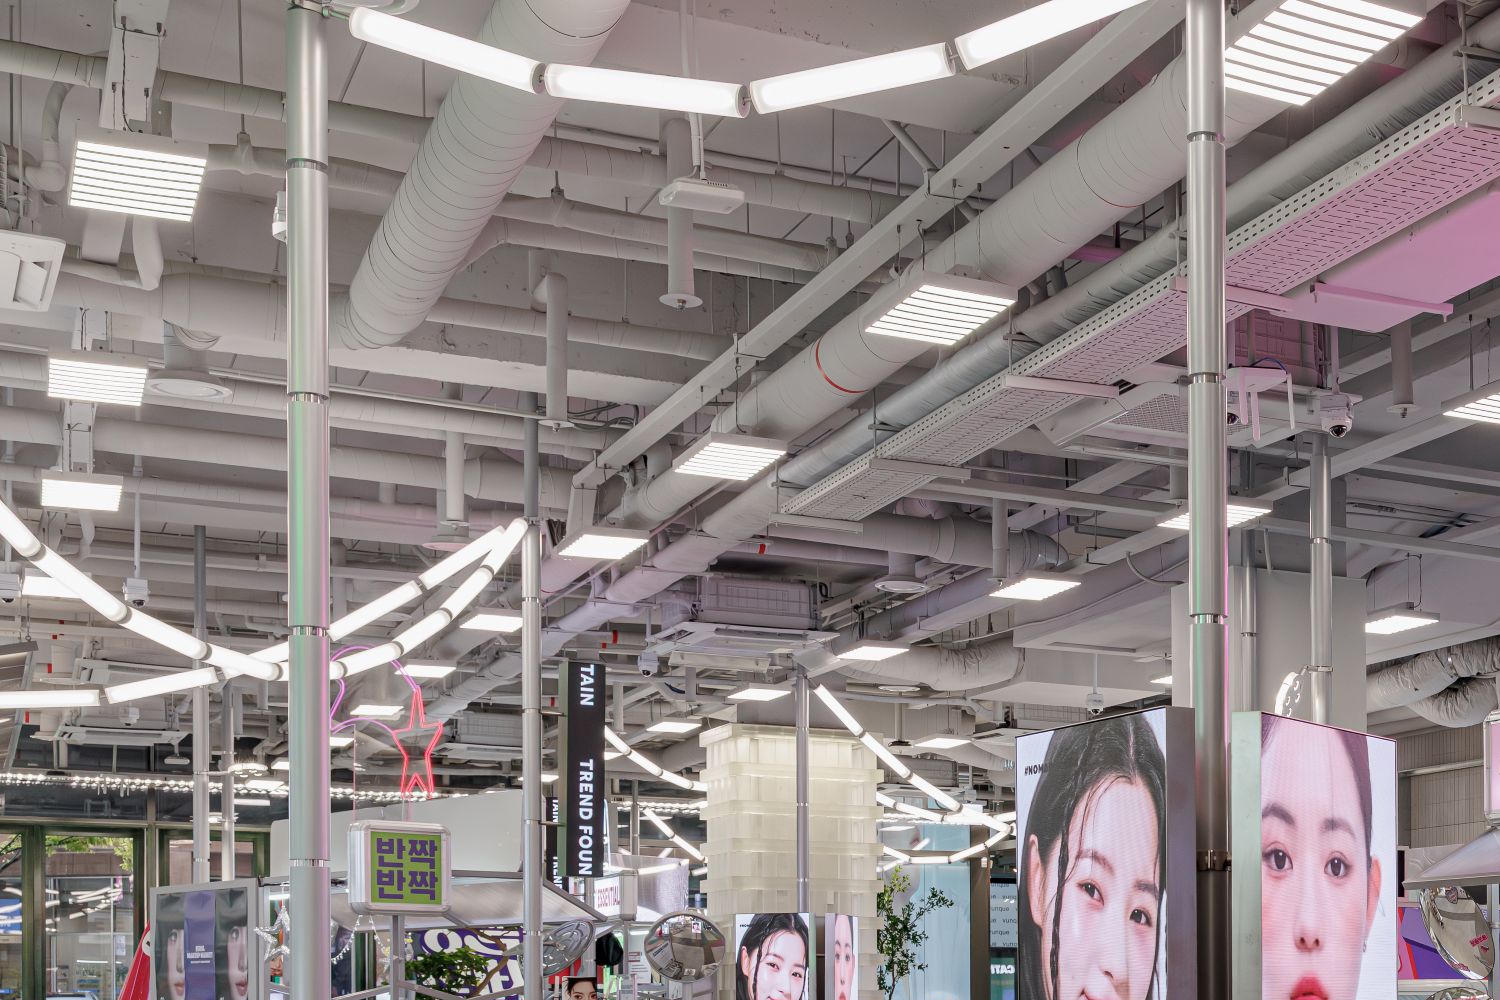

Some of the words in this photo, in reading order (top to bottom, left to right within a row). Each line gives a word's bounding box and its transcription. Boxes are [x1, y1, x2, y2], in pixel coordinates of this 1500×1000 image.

[580, 663, 595, 707] TAIN
[579, 758, 594, 821] TREND
[376, 837, 438, 870] 반짝
[578, 825, 593, 876] FOUN
[376, 869, 438, 901] 반짝
